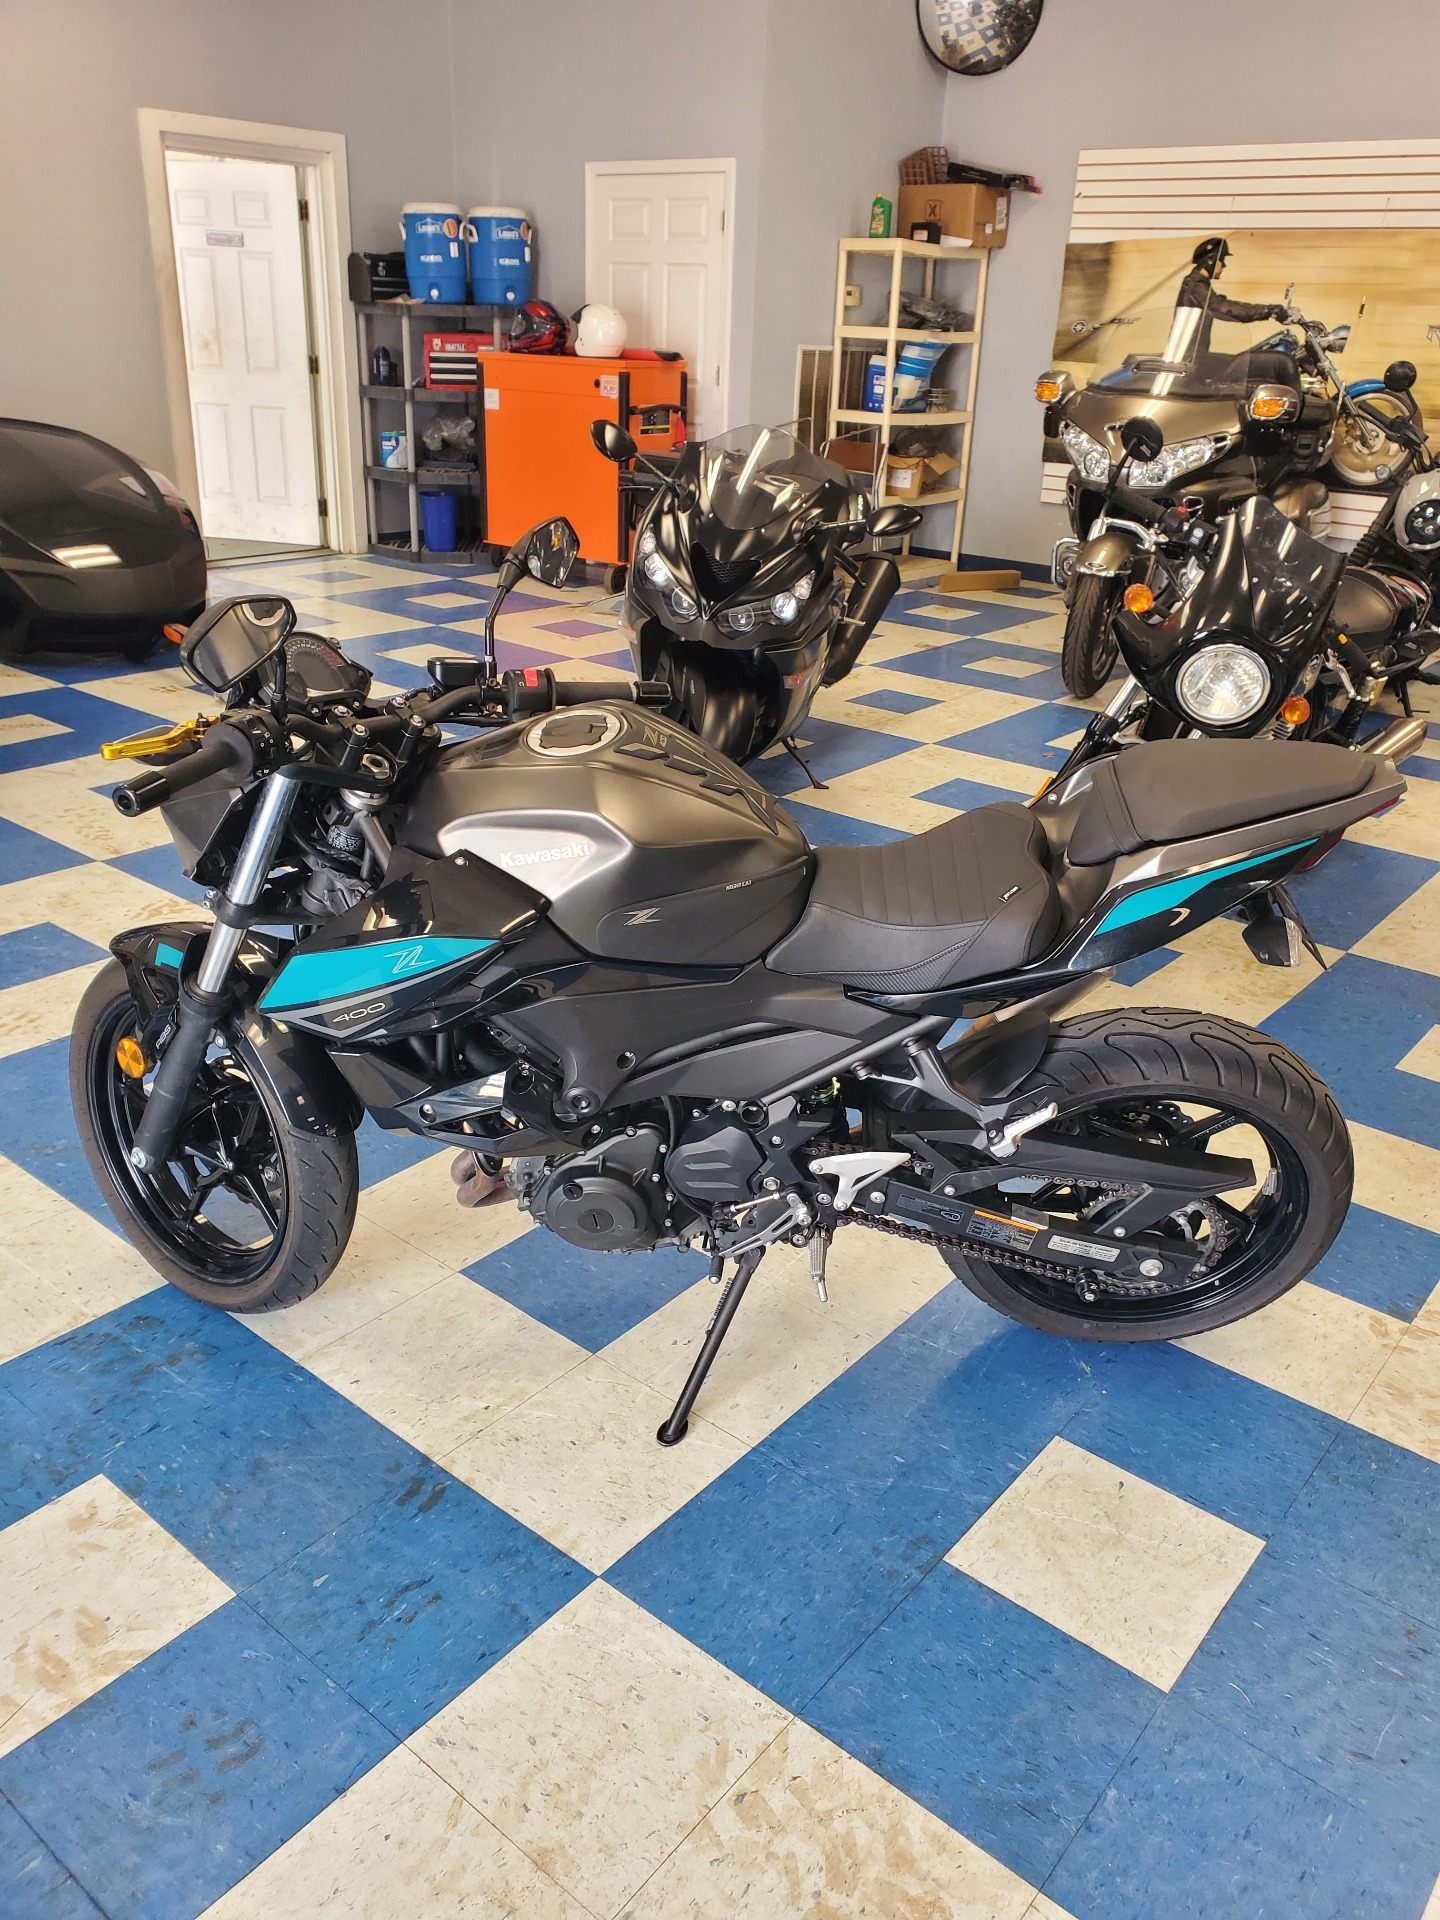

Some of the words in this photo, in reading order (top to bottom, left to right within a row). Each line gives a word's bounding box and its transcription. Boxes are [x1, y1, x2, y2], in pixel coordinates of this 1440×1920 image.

[500, 841, 590, 868] Kawasaki
[383, 945, 437, 974] Z
[332, 1002, 386, 1023] 400
[155, 1024, 171, 1050] ABS
